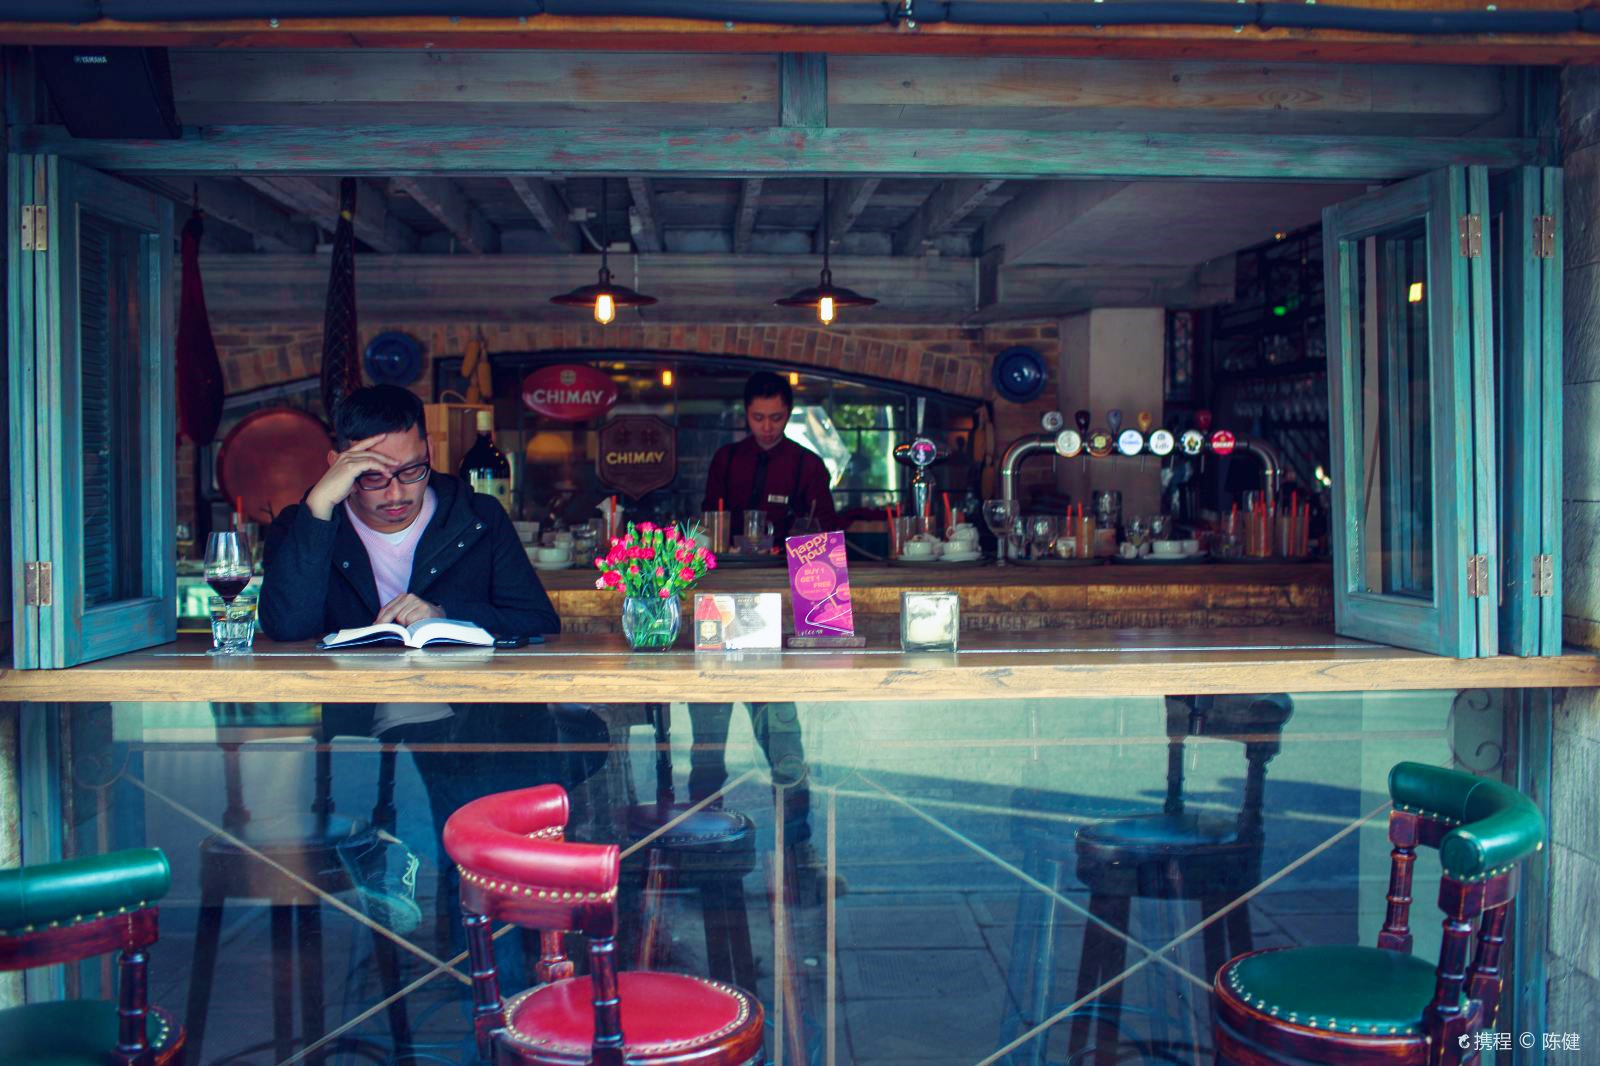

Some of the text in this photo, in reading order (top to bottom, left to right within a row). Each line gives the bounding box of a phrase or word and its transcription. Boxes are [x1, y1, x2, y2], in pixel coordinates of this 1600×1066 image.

[533, 389, 604, 404] CHIMAY
[606, 452, 665, 464] CHIMAY
[785, 532, 828, 558] happy
[797, 543, 827, 564] hour
[804, 568, 819, 576] BUY
[800, 575, 814, 583] GET
